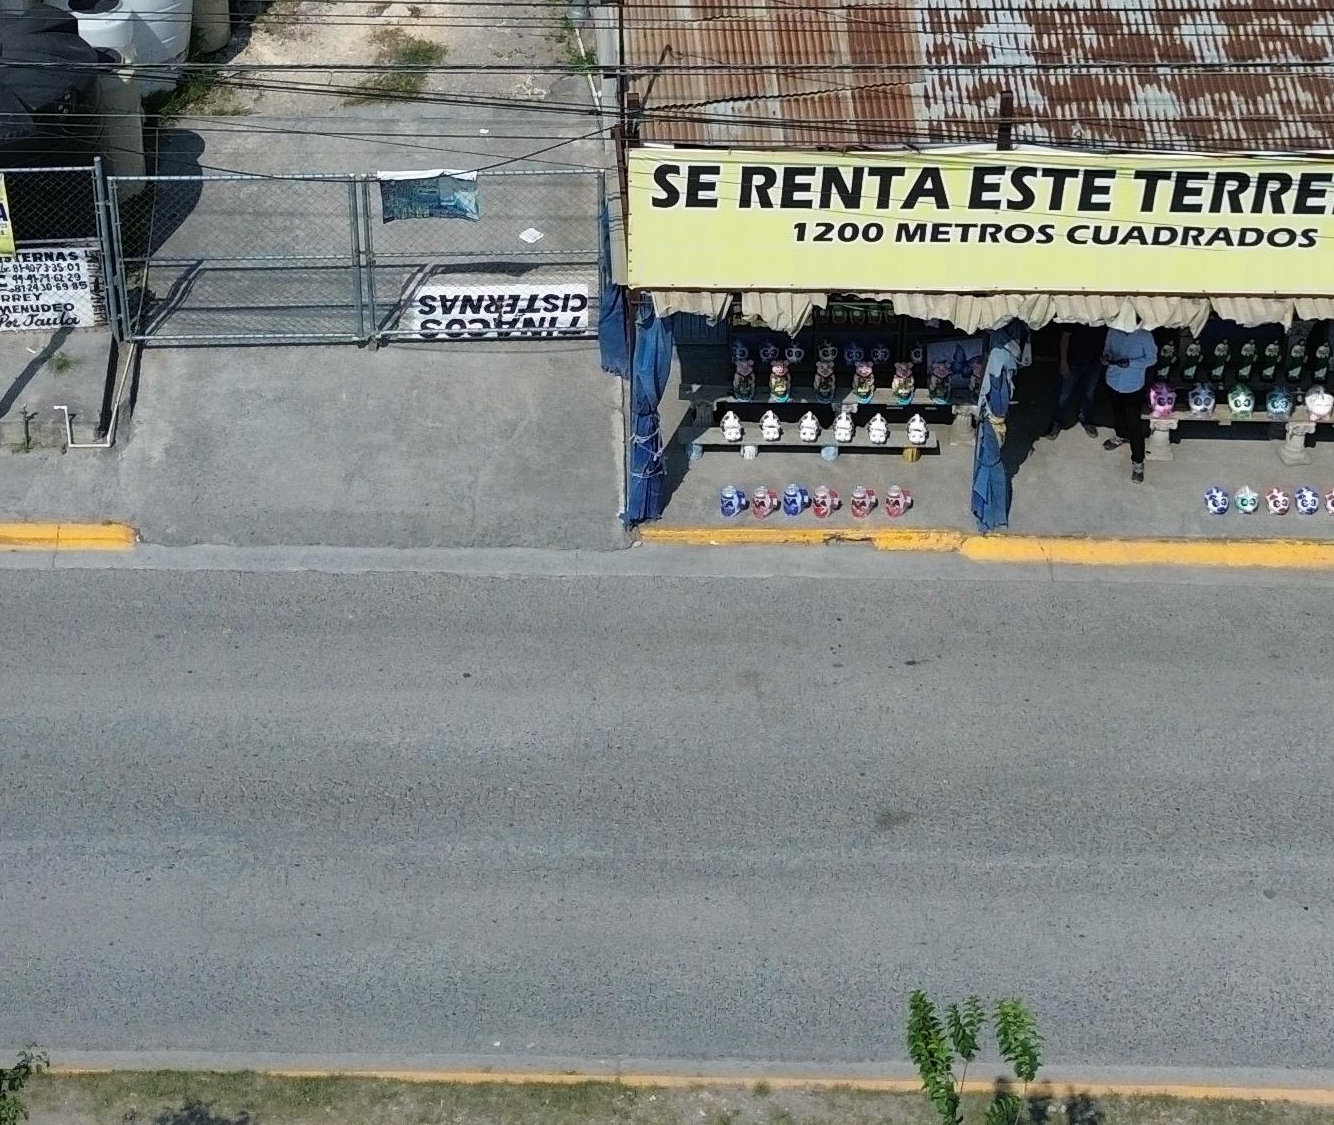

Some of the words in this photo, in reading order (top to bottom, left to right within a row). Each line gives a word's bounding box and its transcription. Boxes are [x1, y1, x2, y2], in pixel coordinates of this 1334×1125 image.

[651, 163, 721, 209] SE
[738, 165, 951, 210] RENTA
[968, 165, 1117, 213] ESTE
[793, 221, 884, 243] 1200
[895, 222, 1055, 244] METROS
[1066, 224, 1320, 248] CUADRADOS
[418, 293, 588, 315] CISTERNAS
